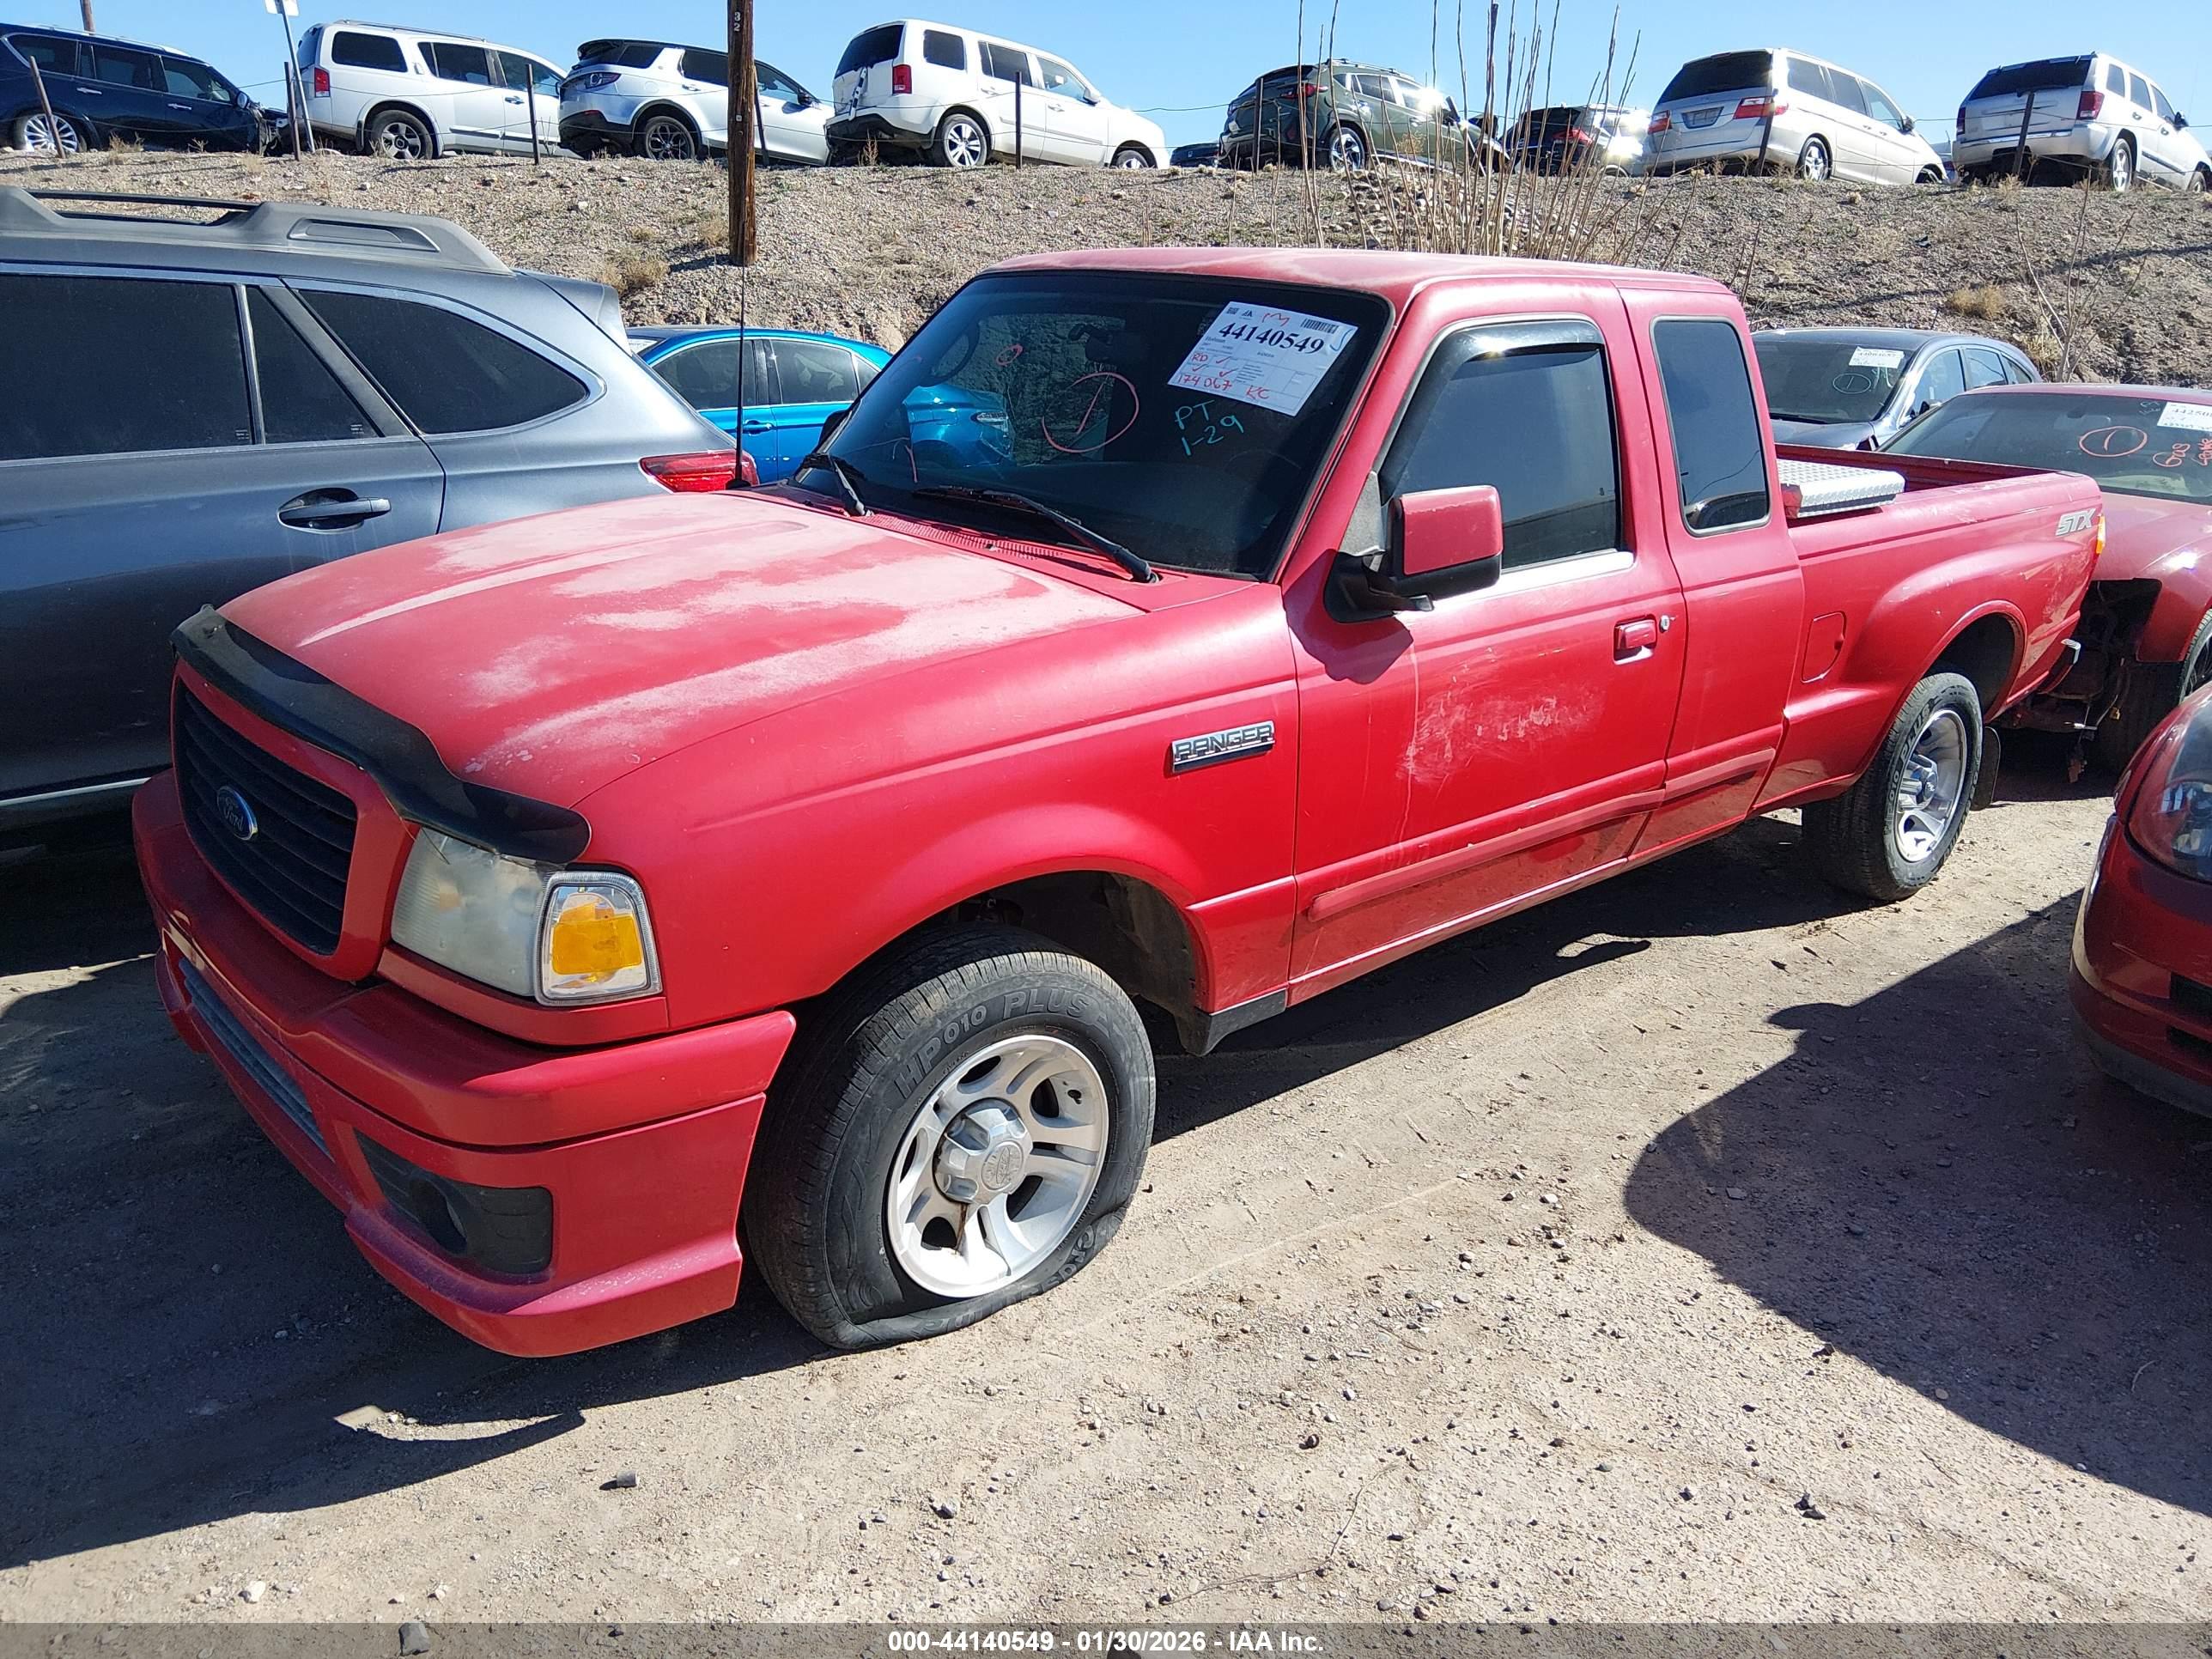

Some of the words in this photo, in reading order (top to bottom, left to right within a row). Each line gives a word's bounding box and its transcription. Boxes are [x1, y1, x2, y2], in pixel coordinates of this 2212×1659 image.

[1218, 322, 1325, 354] 44140549
[2055, 507, 2097, 536] STX
[1175, 724, 1273, 761] RANGER
[1002, 988, 1092, 1020] PLUS
